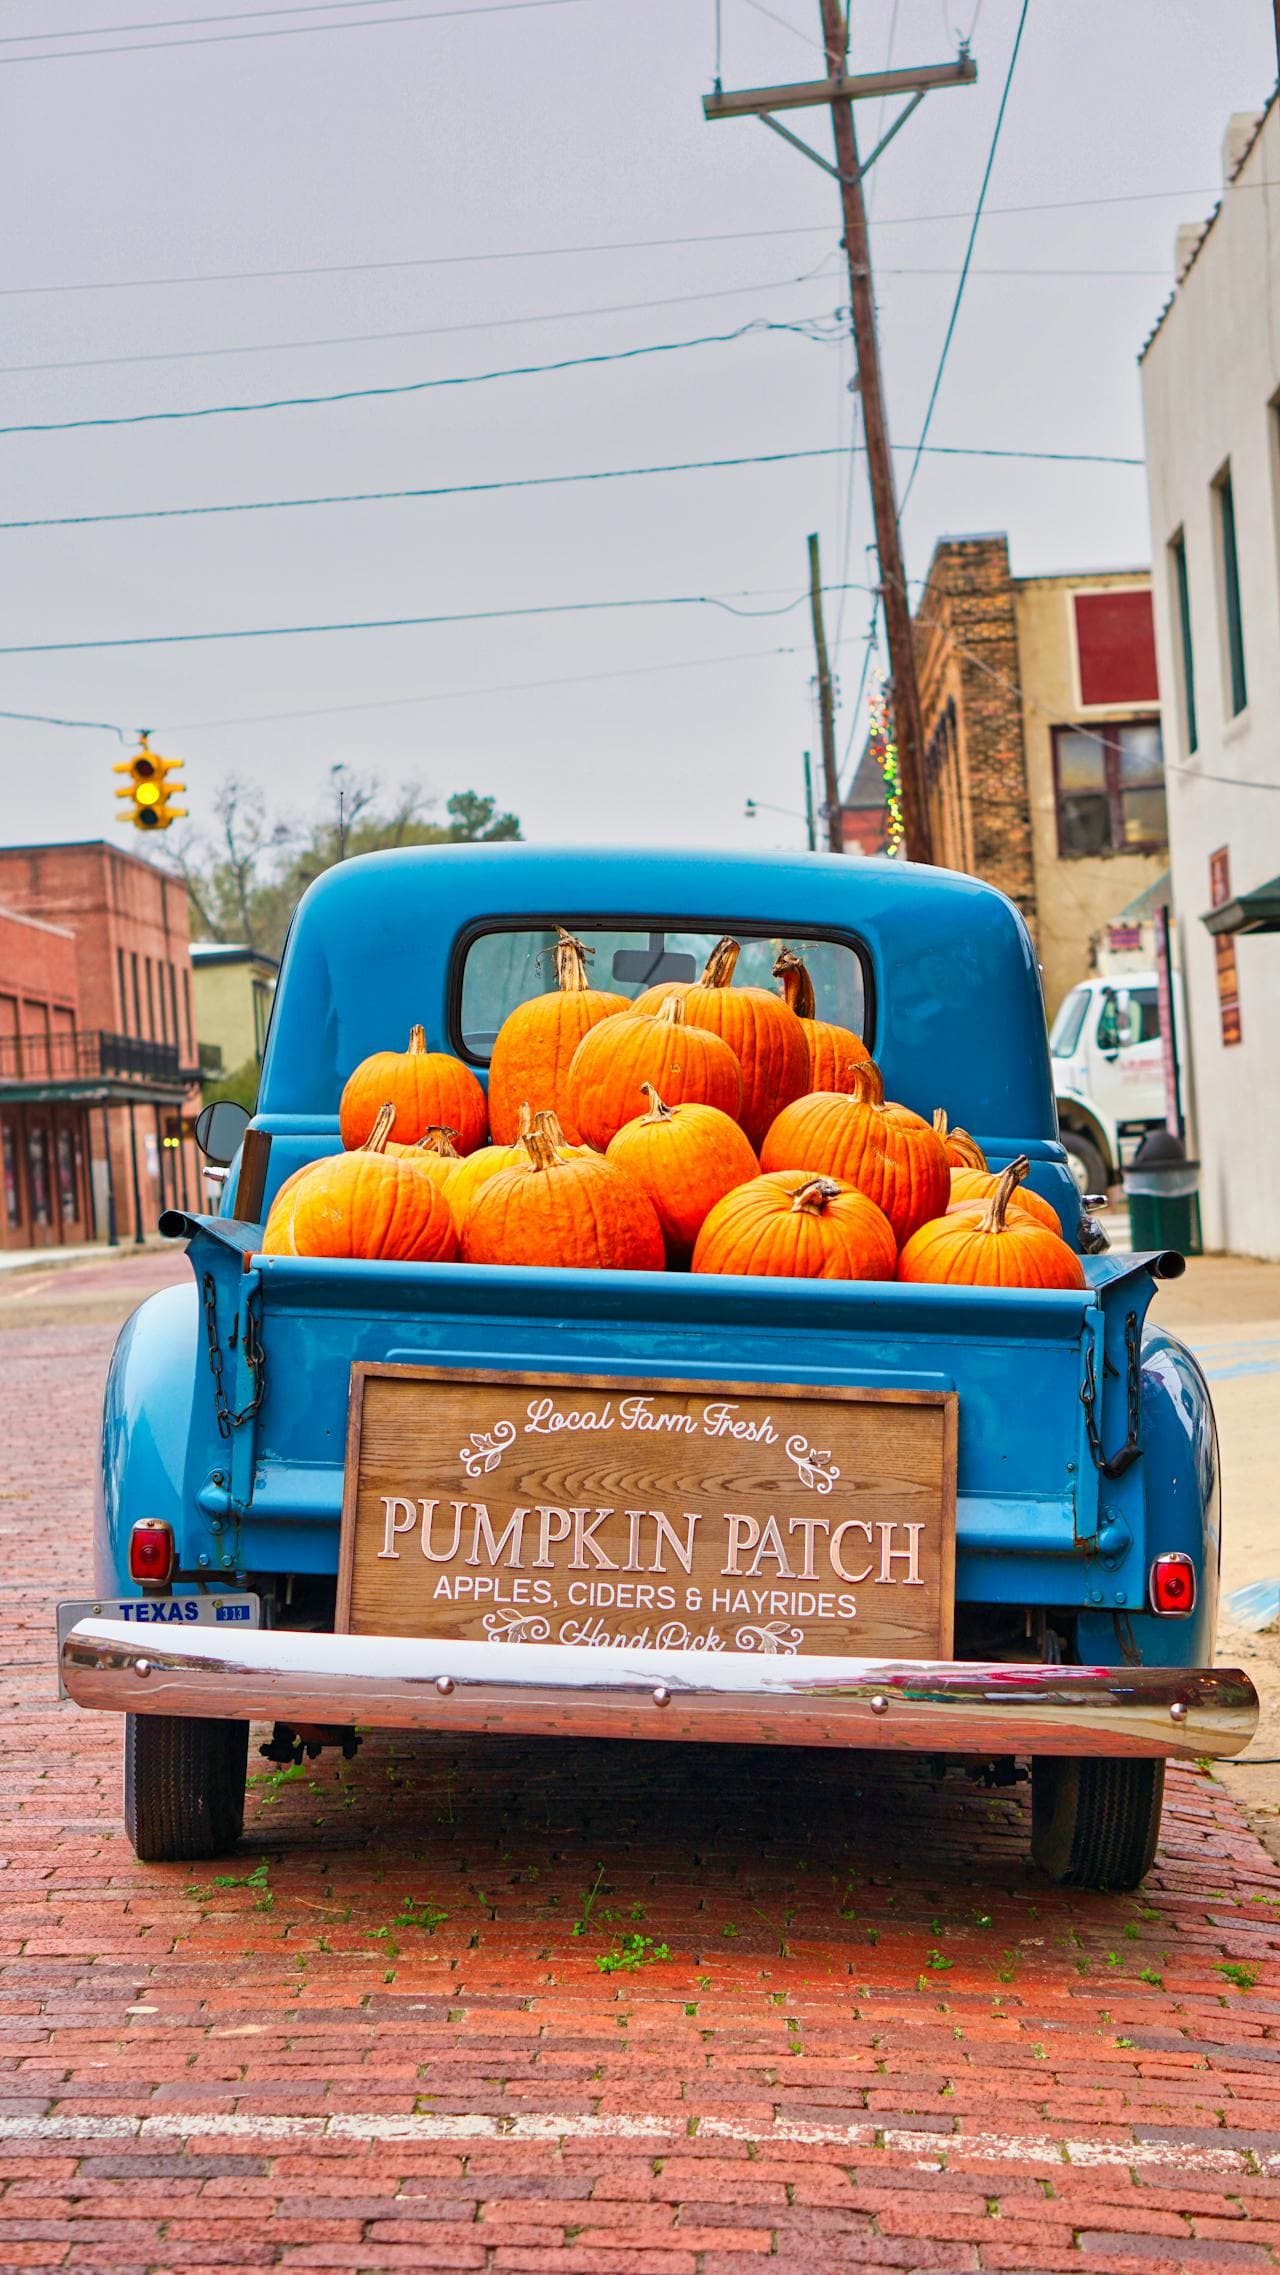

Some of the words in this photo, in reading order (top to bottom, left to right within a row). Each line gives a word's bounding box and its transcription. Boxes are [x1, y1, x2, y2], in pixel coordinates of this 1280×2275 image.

[524, 1398, 614, 1433] Local
[619, 1397, 696, 1434] Farm
[703, 1403, 779, 1444] Fresh
[377, 1496, 702, 1574] PUMPKIN
[720, 1513, 925, 1585] PATCH
[120, 1602, 198, 1622] TEXAS
[432, 1574, 560, 1605] APPLES,
[567, 1583, 676, 1610] CIDERS
[686, 1588, 702, 1611] &
[712, 1588, 857, 1618] HAYRIDES
[559, 1617, 651, 1649] Hand
[655, 1621, 726, 1651] Pick
